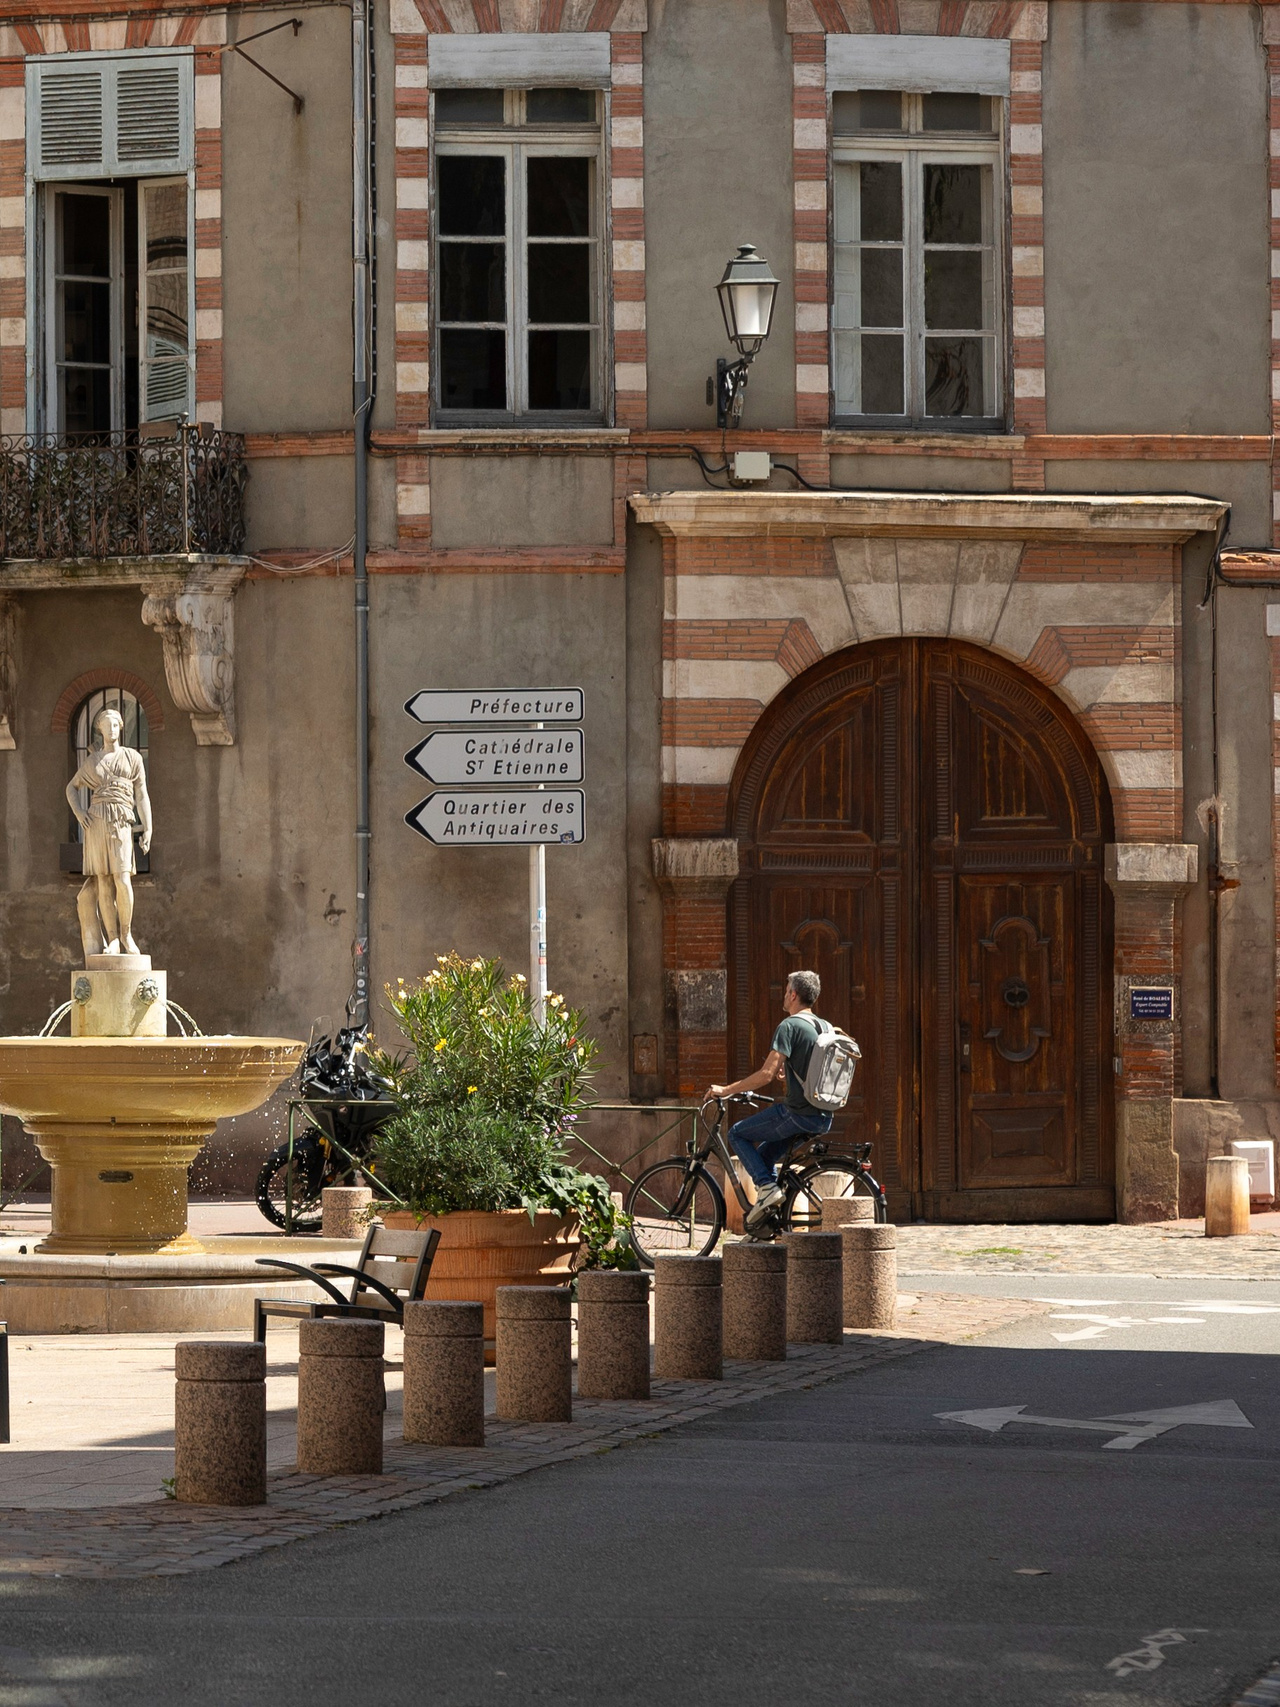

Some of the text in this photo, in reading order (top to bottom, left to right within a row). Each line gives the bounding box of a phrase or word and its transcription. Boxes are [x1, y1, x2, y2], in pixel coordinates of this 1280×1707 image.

[470, 698, 574, 714] Préfecture
[465, 738, 574, 755] Cathédrale
[493, 760, 569, 775] Etienne
[443, 799, 575, 815] Quartier des
[443, 820, 559, 839] Antiquaires
